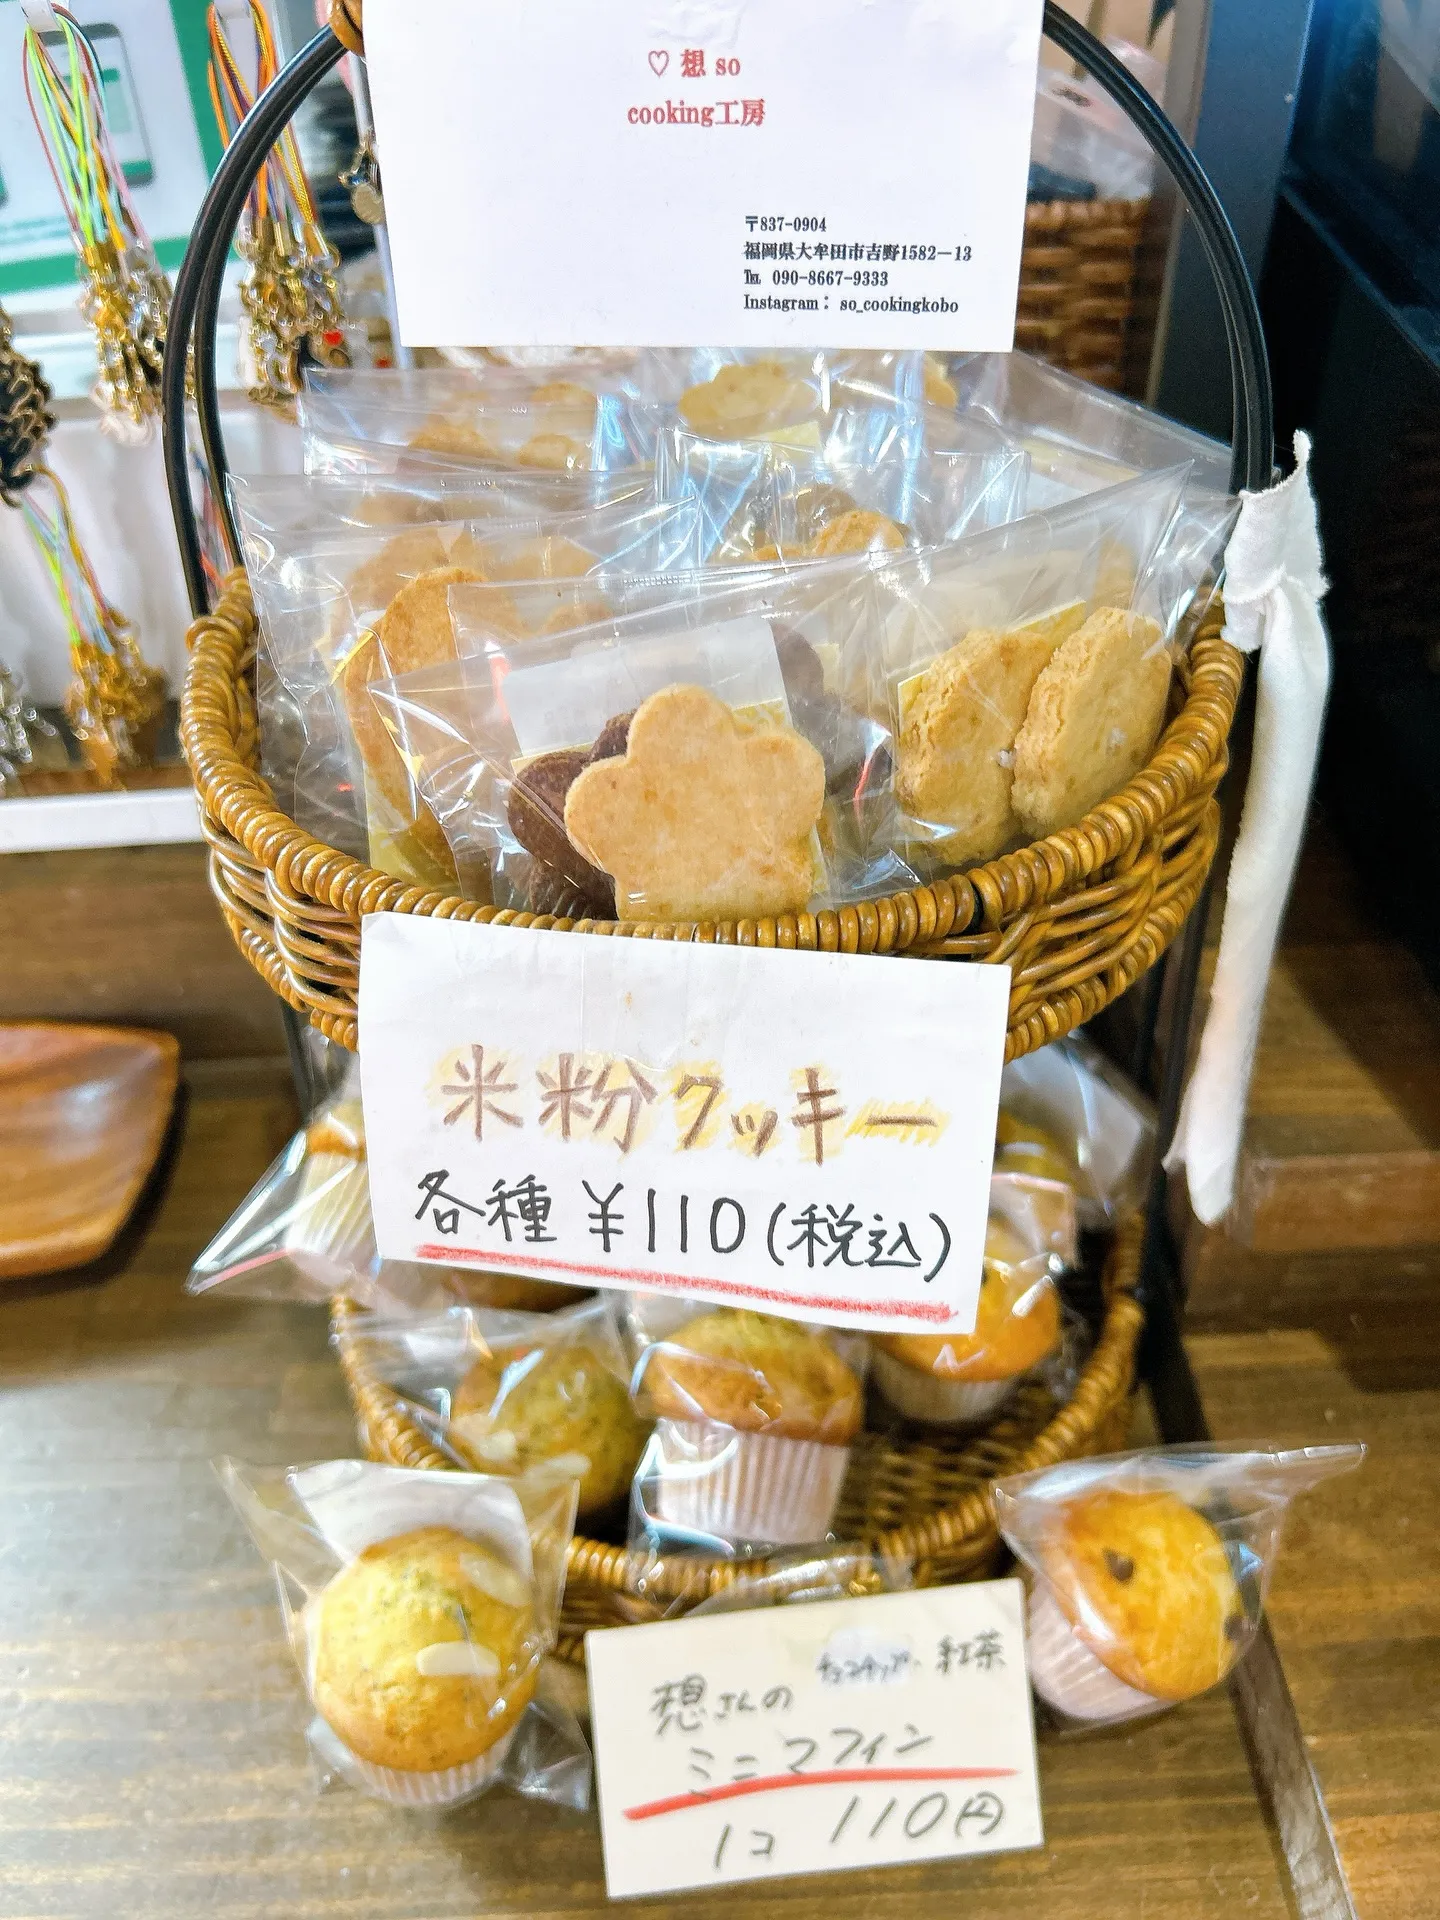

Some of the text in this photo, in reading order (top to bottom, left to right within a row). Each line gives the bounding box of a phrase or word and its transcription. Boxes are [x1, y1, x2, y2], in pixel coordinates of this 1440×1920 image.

[681, 49, 741, 78] 想 so
[627, 98, 766, 127] cooking工房
[772, 270, 889, 286] 090-8667-9333
[839, 296, 959, 315] so_cookingkobo
[441, 1043, 937, 1166] 米粉クッキー
[414, 1168, 556, 1243] 各種
[936, 1628, 1008, 1674] 紅茶
[650, 1674, 795, 1736] 想さんの
[829, 1791, 1006, 1844] 110円
